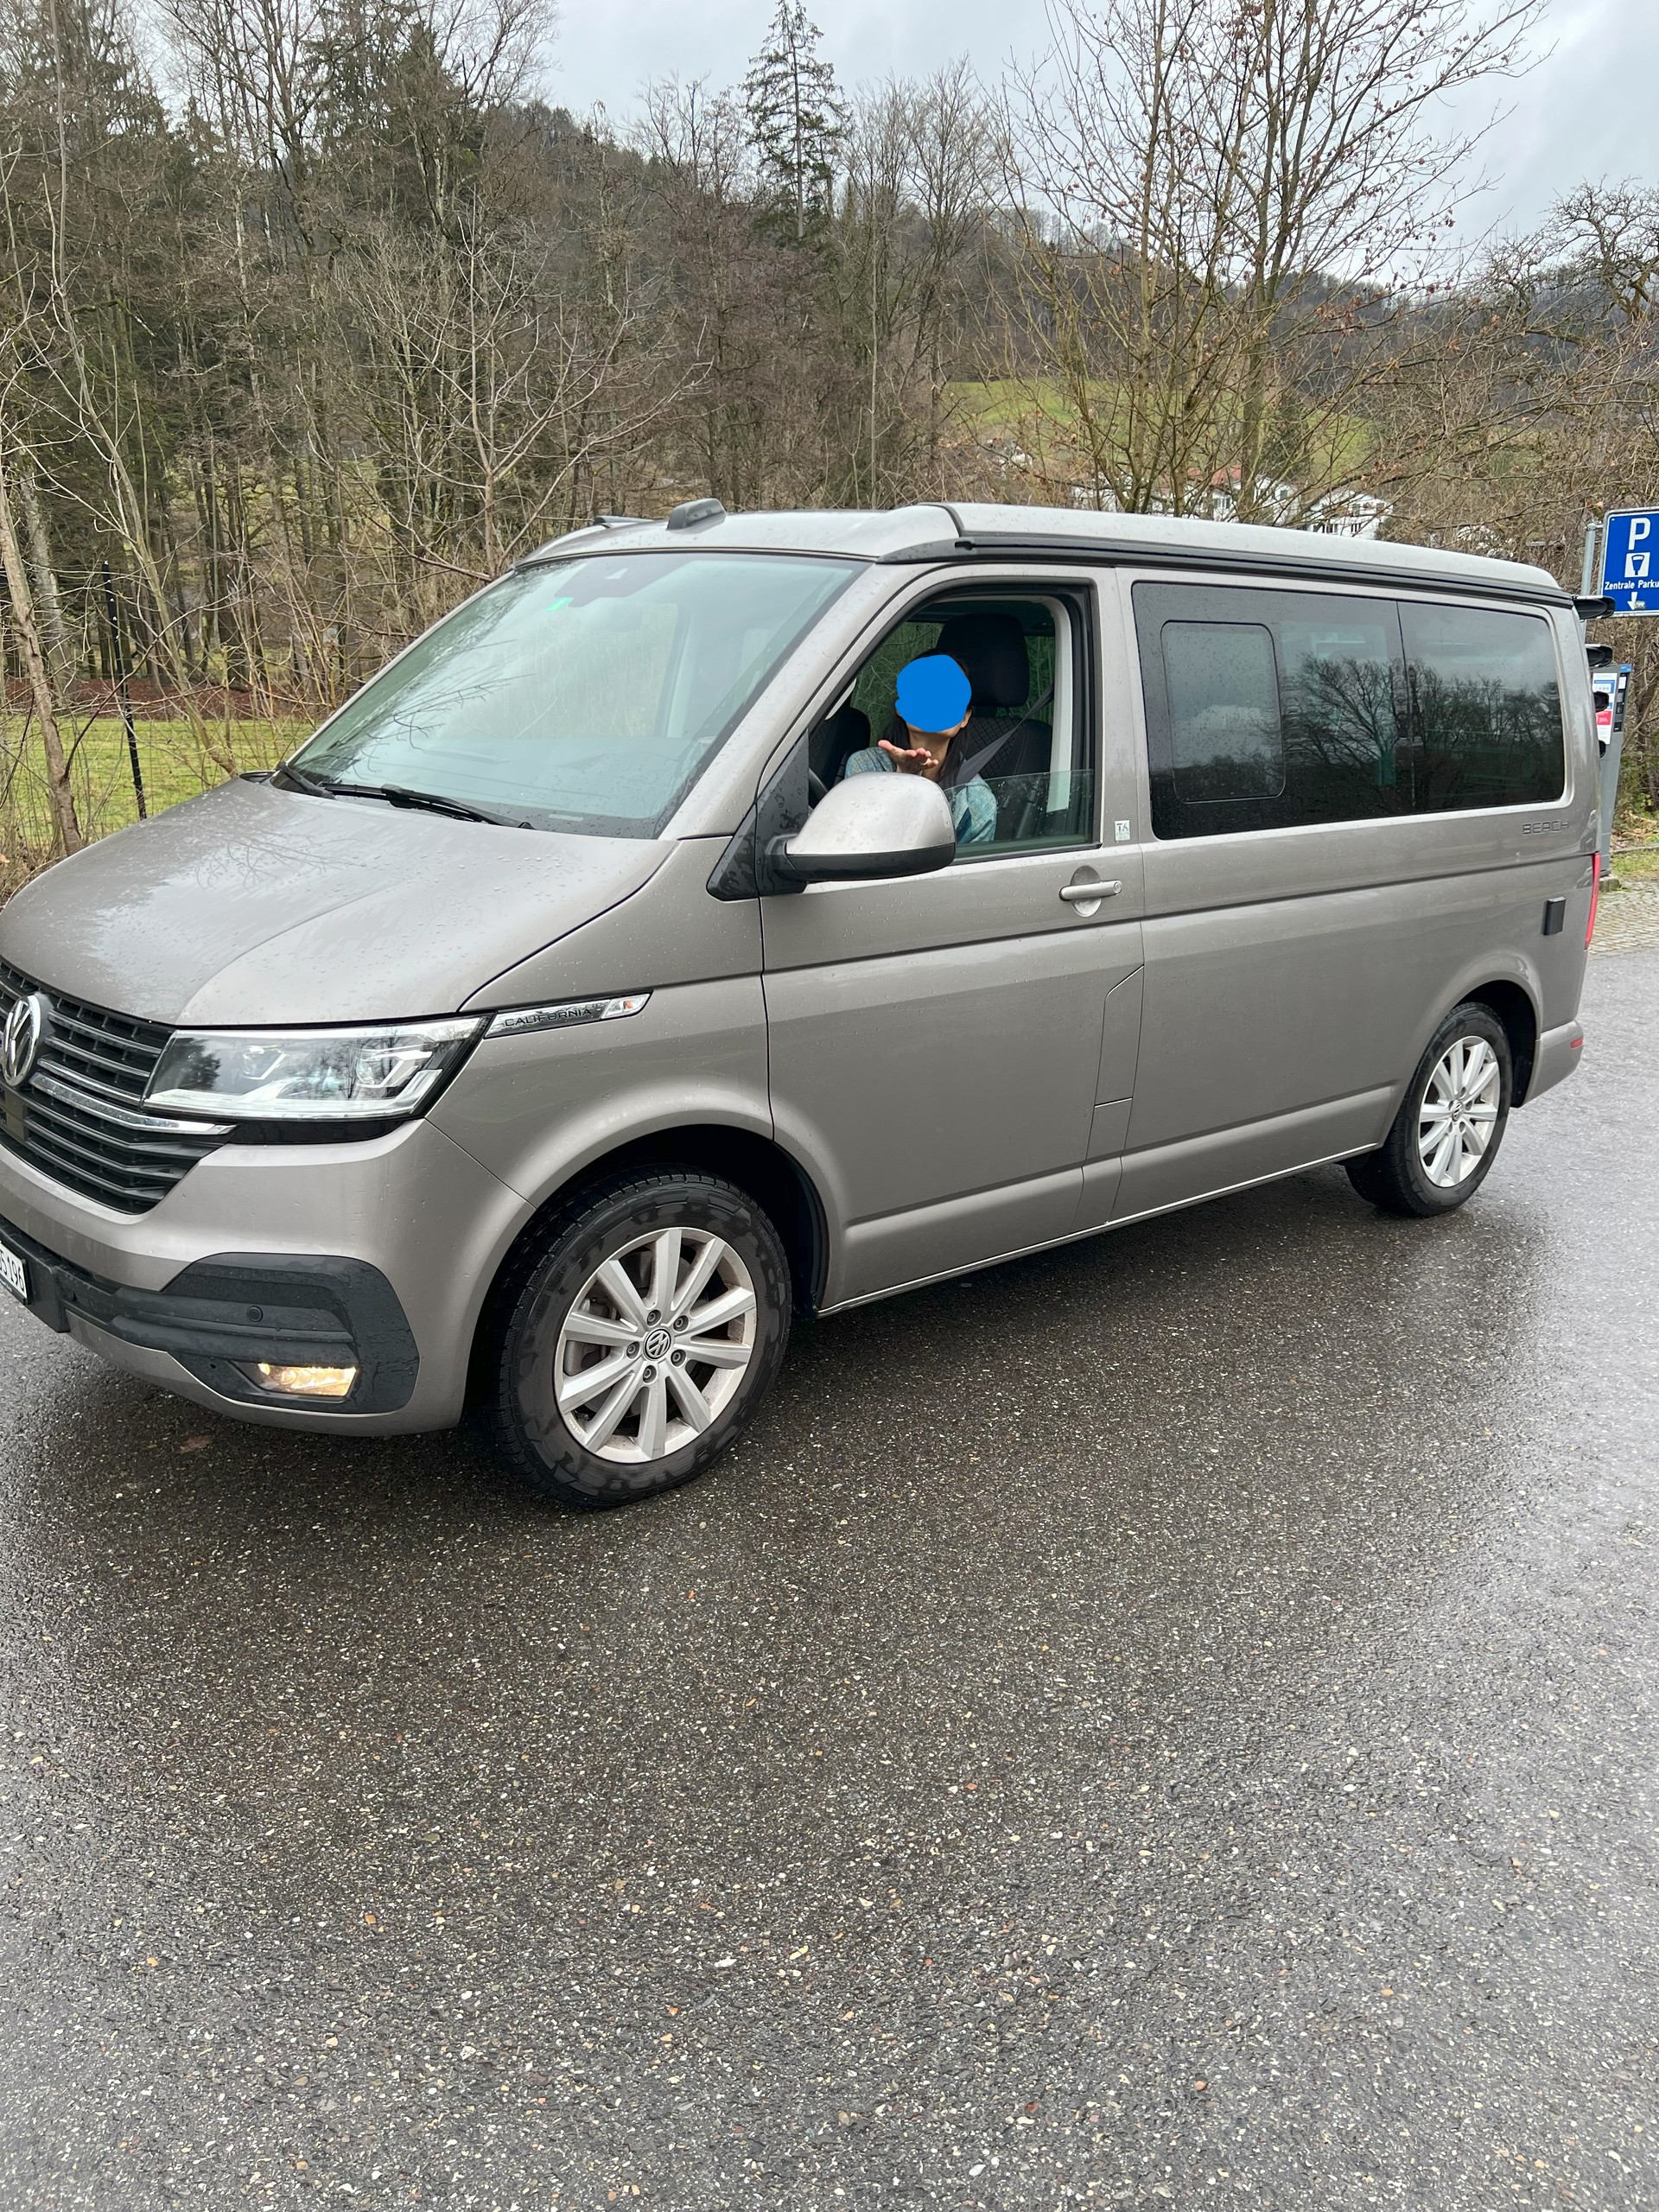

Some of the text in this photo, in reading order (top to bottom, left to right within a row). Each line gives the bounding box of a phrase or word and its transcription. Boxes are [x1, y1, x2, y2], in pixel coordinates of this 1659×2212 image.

[1628, 517, 1650, 550] P
[1605, 578, 1659, 590] Zentrale Parku
[1522, 820, 1570, 836] BEACH
[505, 1008, 592, 1027] CALIFORNIA
[0, 1249, 25, 1293] 5196
